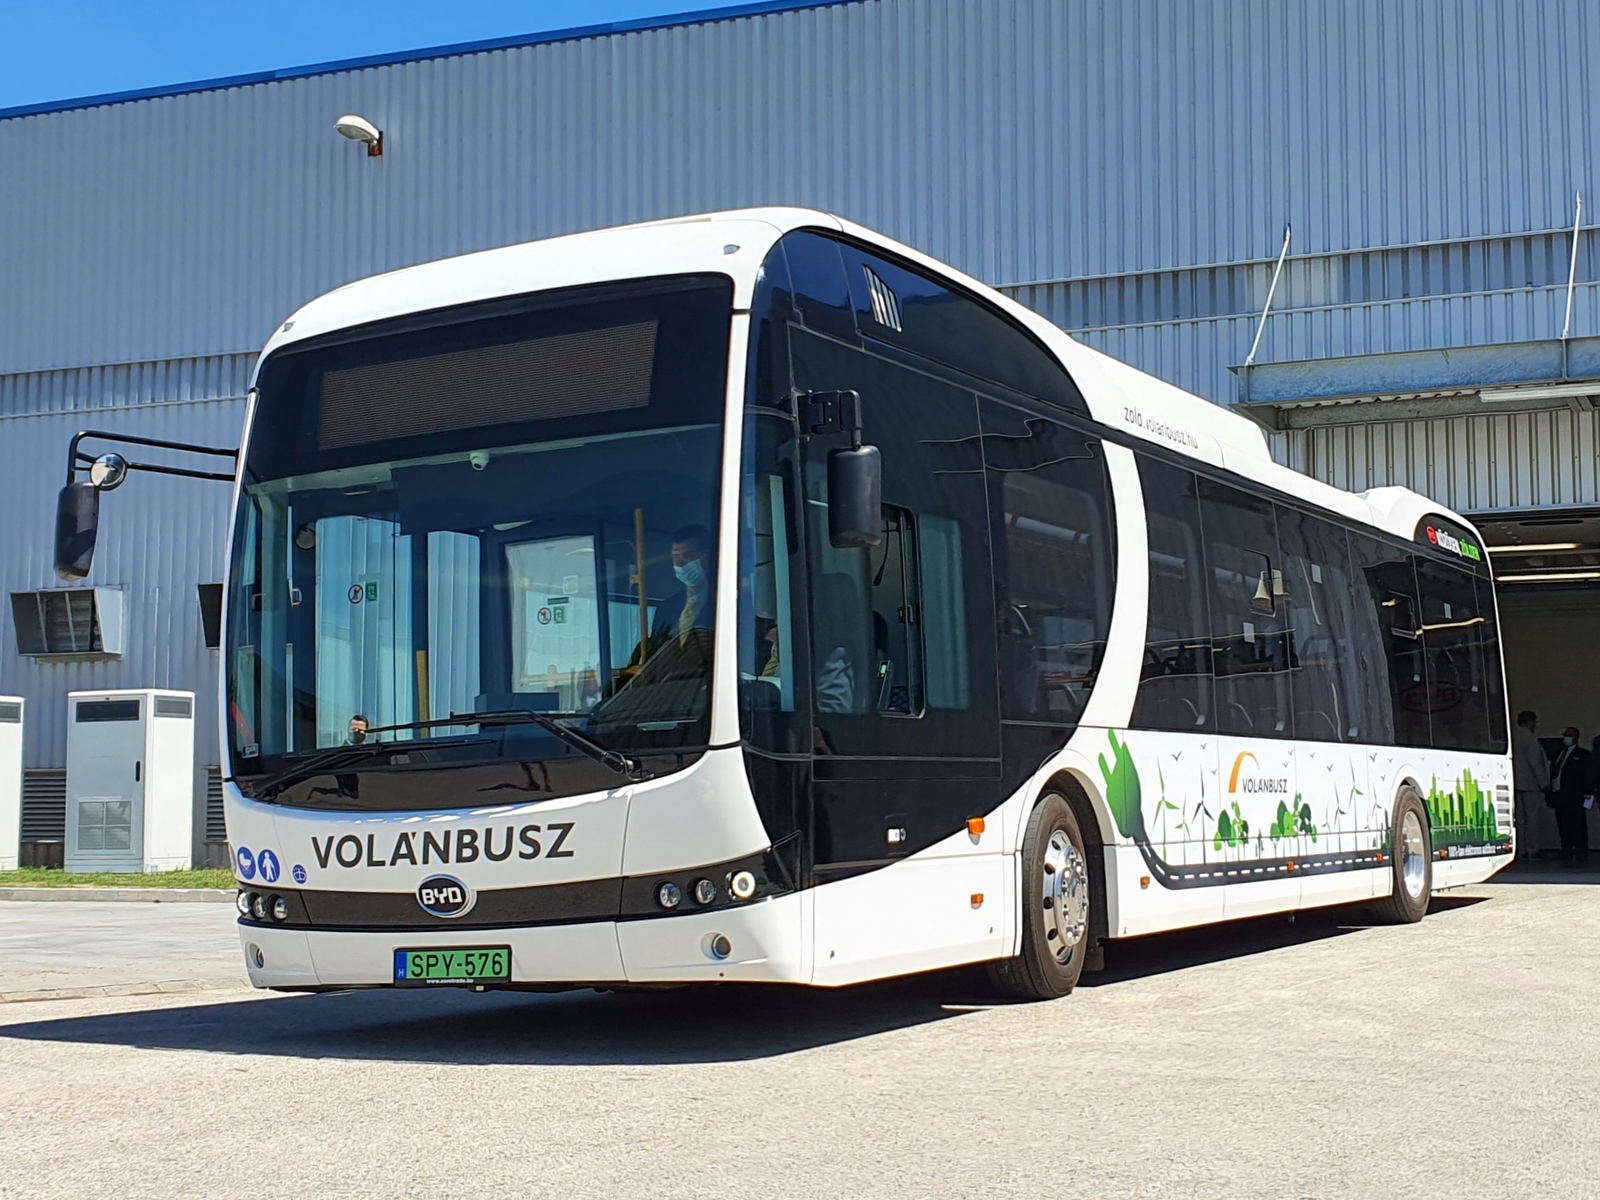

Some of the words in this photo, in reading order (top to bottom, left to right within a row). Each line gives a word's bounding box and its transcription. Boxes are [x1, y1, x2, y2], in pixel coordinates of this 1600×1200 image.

[1242, 778, 1287, 793] VOLÁNBUSZ
[311, 822, 575, 868] VOLÁNBUSZ
[421, 887, 463, 905] BYD
[411, 953, 502, 977] SPY-576
